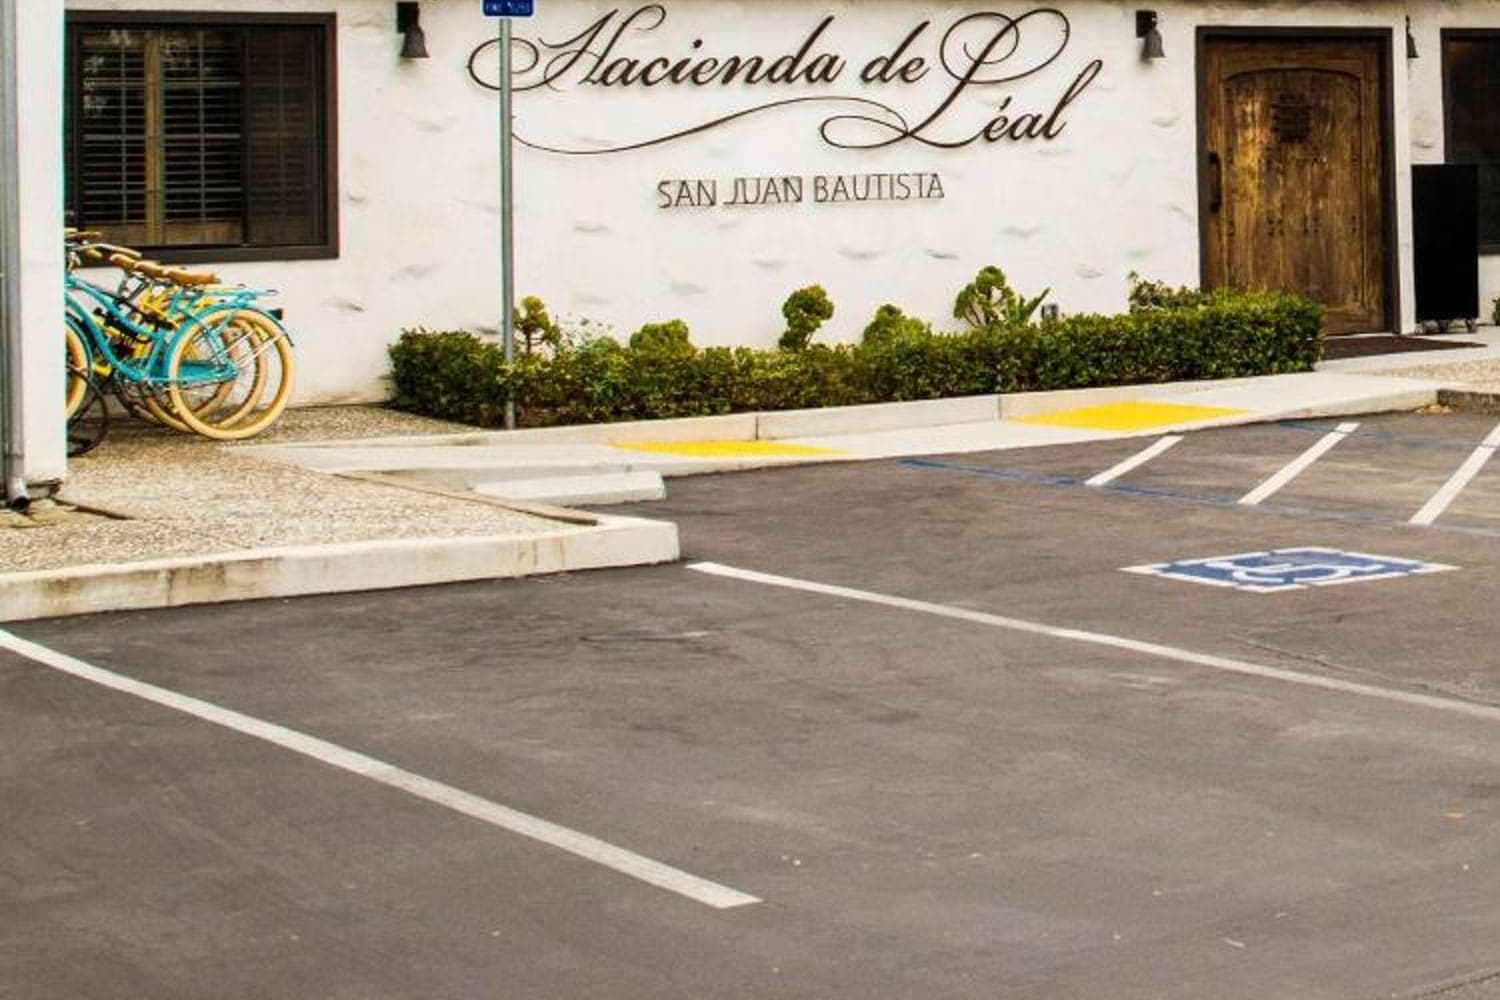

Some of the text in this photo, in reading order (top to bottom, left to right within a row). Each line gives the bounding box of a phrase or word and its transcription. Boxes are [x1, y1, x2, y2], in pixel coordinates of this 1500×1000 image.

[466, 3, 1103, 149] Hacienda de Léal
[656, 172, 946, 209] SAN JUAN BAUTISTA
